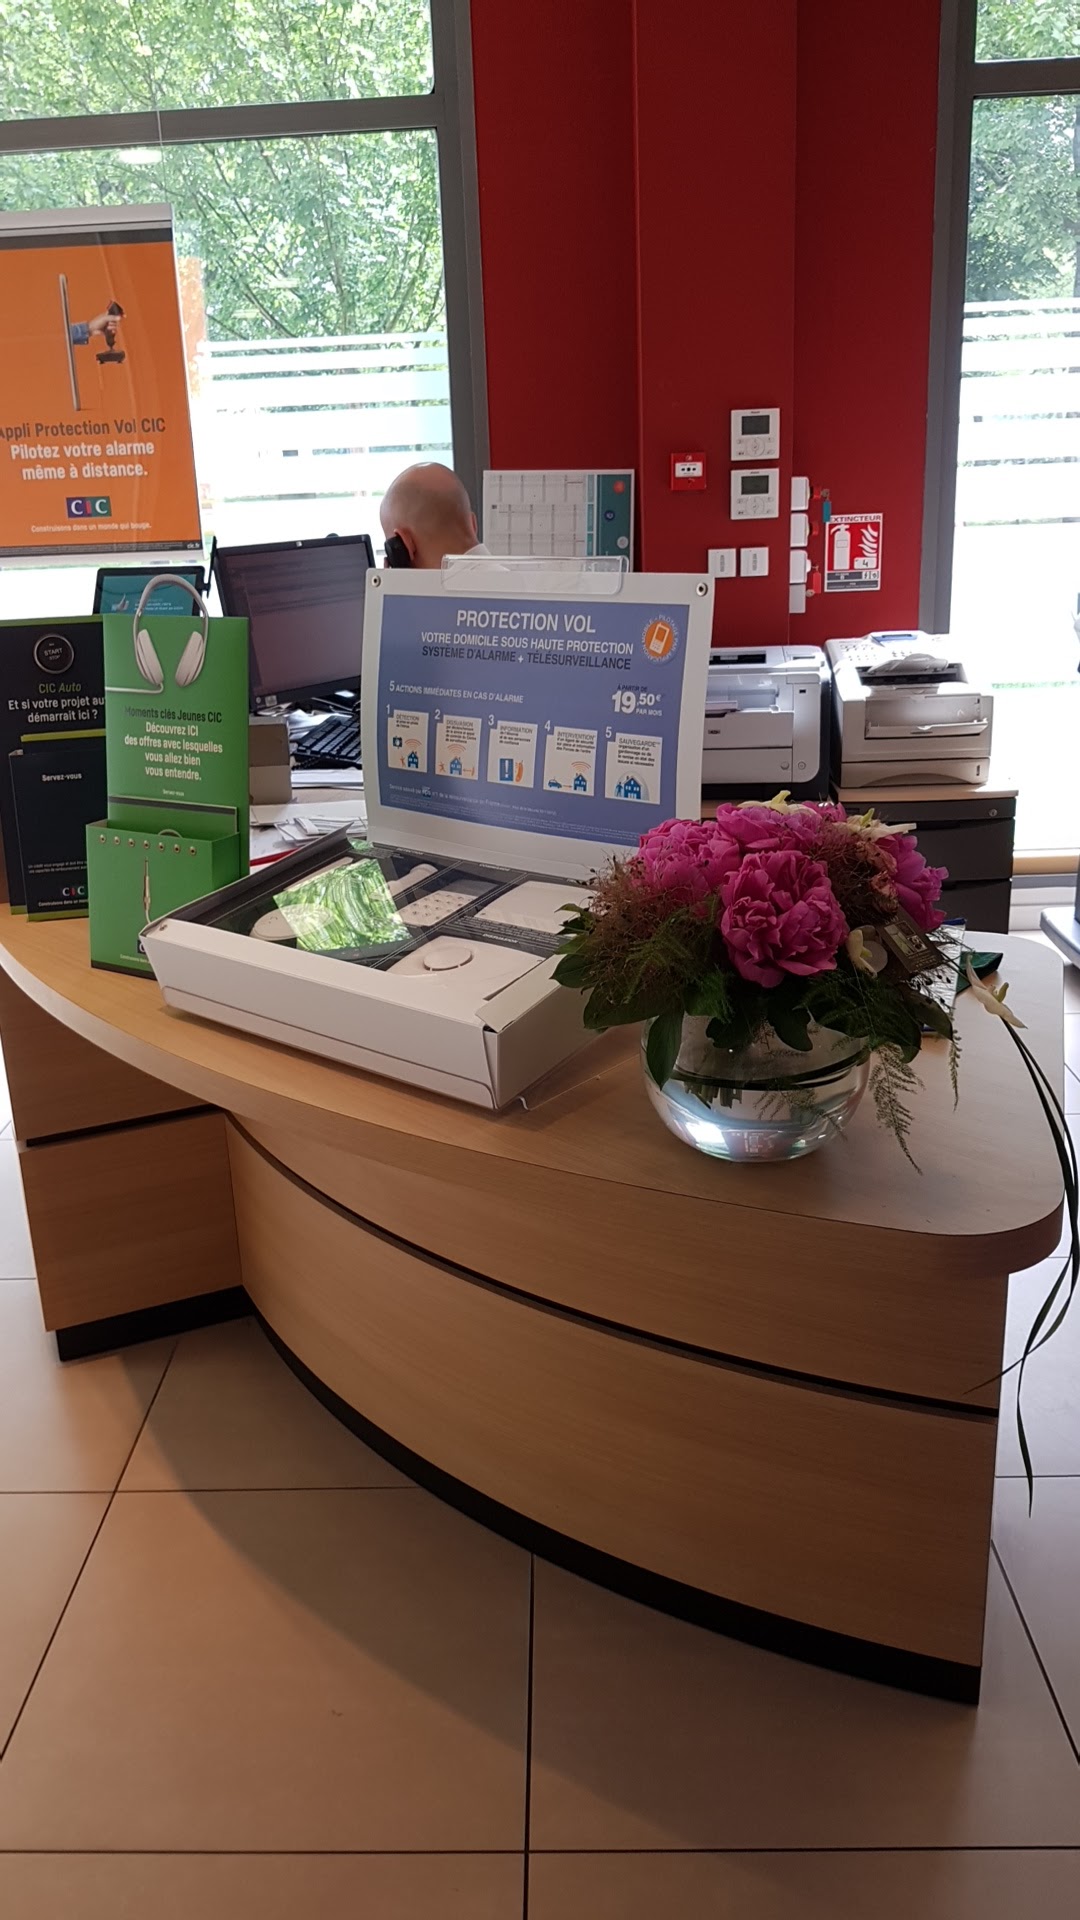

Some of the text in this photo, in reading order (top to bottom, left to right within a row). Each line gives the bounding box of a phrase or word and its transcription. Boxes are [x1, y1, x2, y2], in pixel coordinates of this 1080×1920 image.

[0, 417, 166, 441] Appli Protection Vol CIC
[10, 440, 154, 460] Pilotez votre alarme
[22, 462, 148, 480] même à distance.
[71, 499, 108, 515] CIC
[31, 525, 72, 533] Construisons
[73, 524, 88, 532] dans
[98, 523, 119, 531] monde
[120, 523, 130, 531] qui
[456, 609, 596, 633] PROTECTION VOL
[421, 631, 634, 655] VOTRE DOMICILE SOUS HAUTE PROTECTION
[422, 644, 631, 670] SYSTÈME D'ALARME + TÉLÉSURVEILLANCE
[38, 682, 82, 694] CIC Auto
[389, 680, 524, 704] 5 ACTIONS IMMÉDIATES EN CAS D'ALARME
[8, 696, 106, 710] Et si votre projet au
[386, 703, 391, 715] 1
[28, 709, 98, 723] démarrait ici ?
[124, 705, 222, 723] Moments clés Jeunes CIC
[434, 709, 441, 720] 2
[488, 714, 495, 726] 3
[648, 709, 663, 717] MOIS
[145, 721, 199, 737] Découvrez ICI
[544, 720, 551, 732] 4
[605, 726, 612, 738] 5
[124, 734, 223, 753] des offres avec lesquelles
[144, 752, 201, 766] vous allez bien
[41, 773, 82, 782] Servez-vous
[144, 766, 202, 781] vous entendre.
[62, 886, 85, 897] CIC
